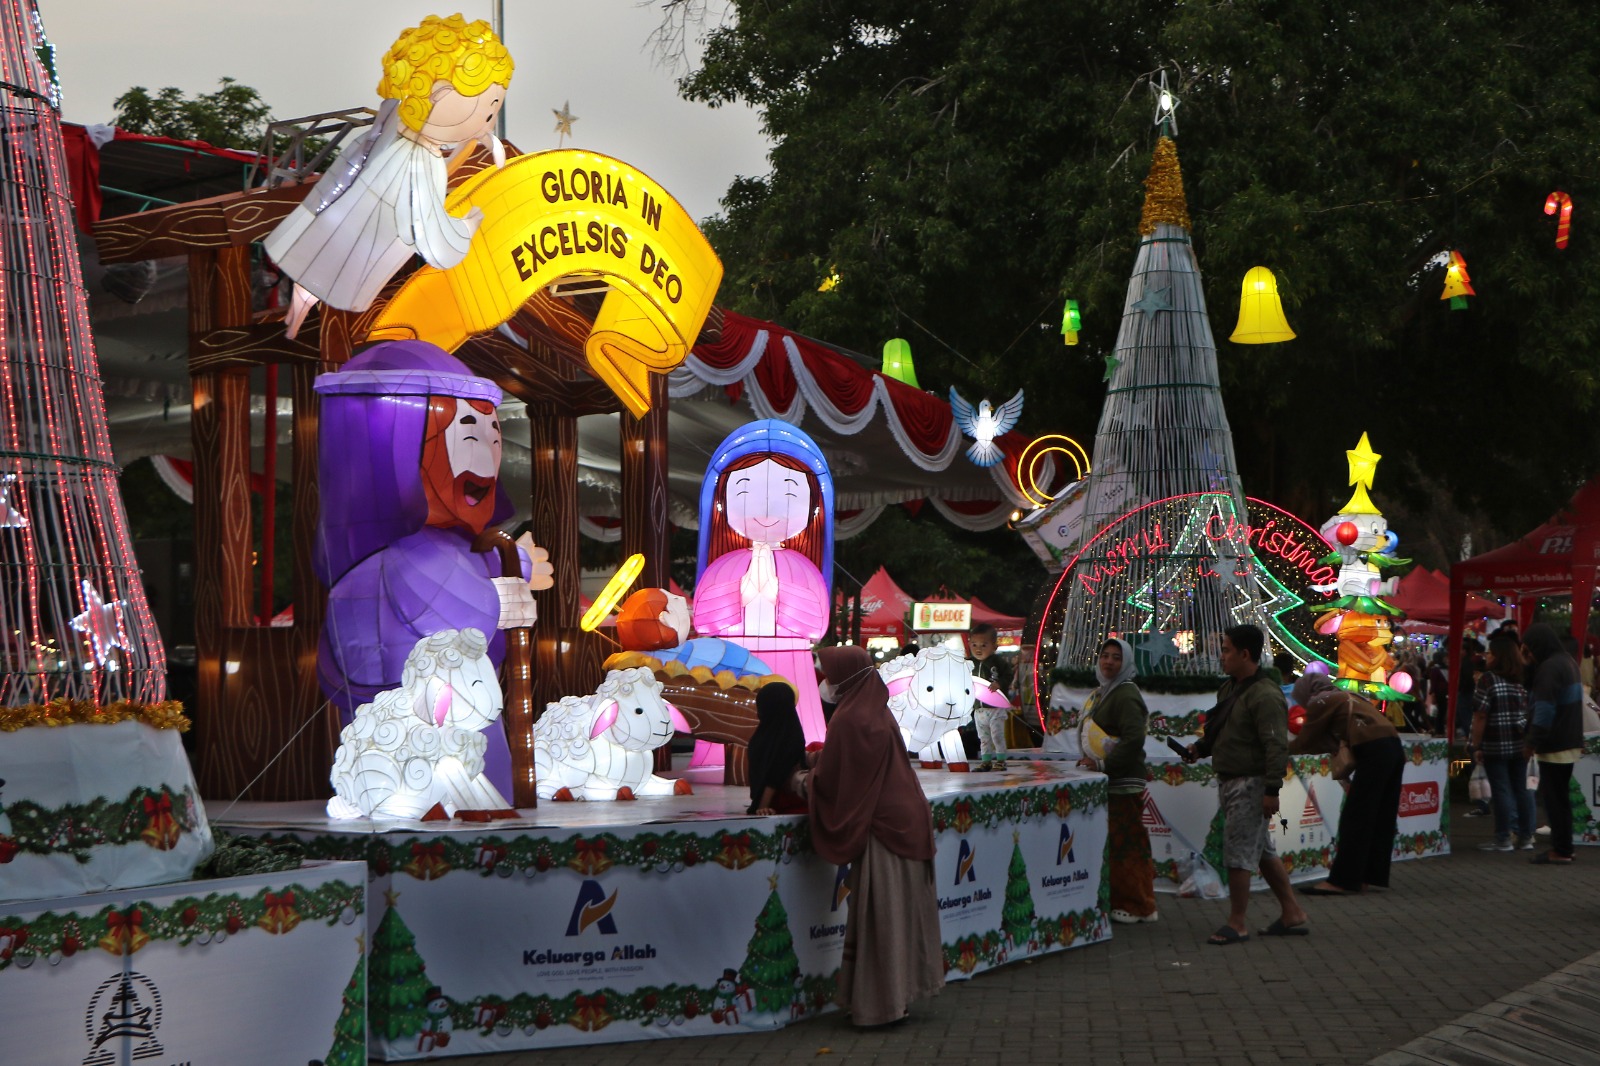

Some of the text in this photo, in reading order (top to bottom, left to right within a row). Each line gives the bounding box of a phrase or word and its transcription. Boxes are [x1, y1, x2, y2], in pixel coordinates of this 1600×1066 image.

[541, 168, 662, 232] GLORIA IN
[511, 221, 682, 304] EXCELSIS DEO
[933, 609, 965, 622] GARDOE
[1042, 874, 1071, 888] Keluarga
[937, 888, 992, 910] Keluarga Allah
[810, 924, 848, 940] Keluarg
[523, 943, 657, 967] Keluarga Allah
